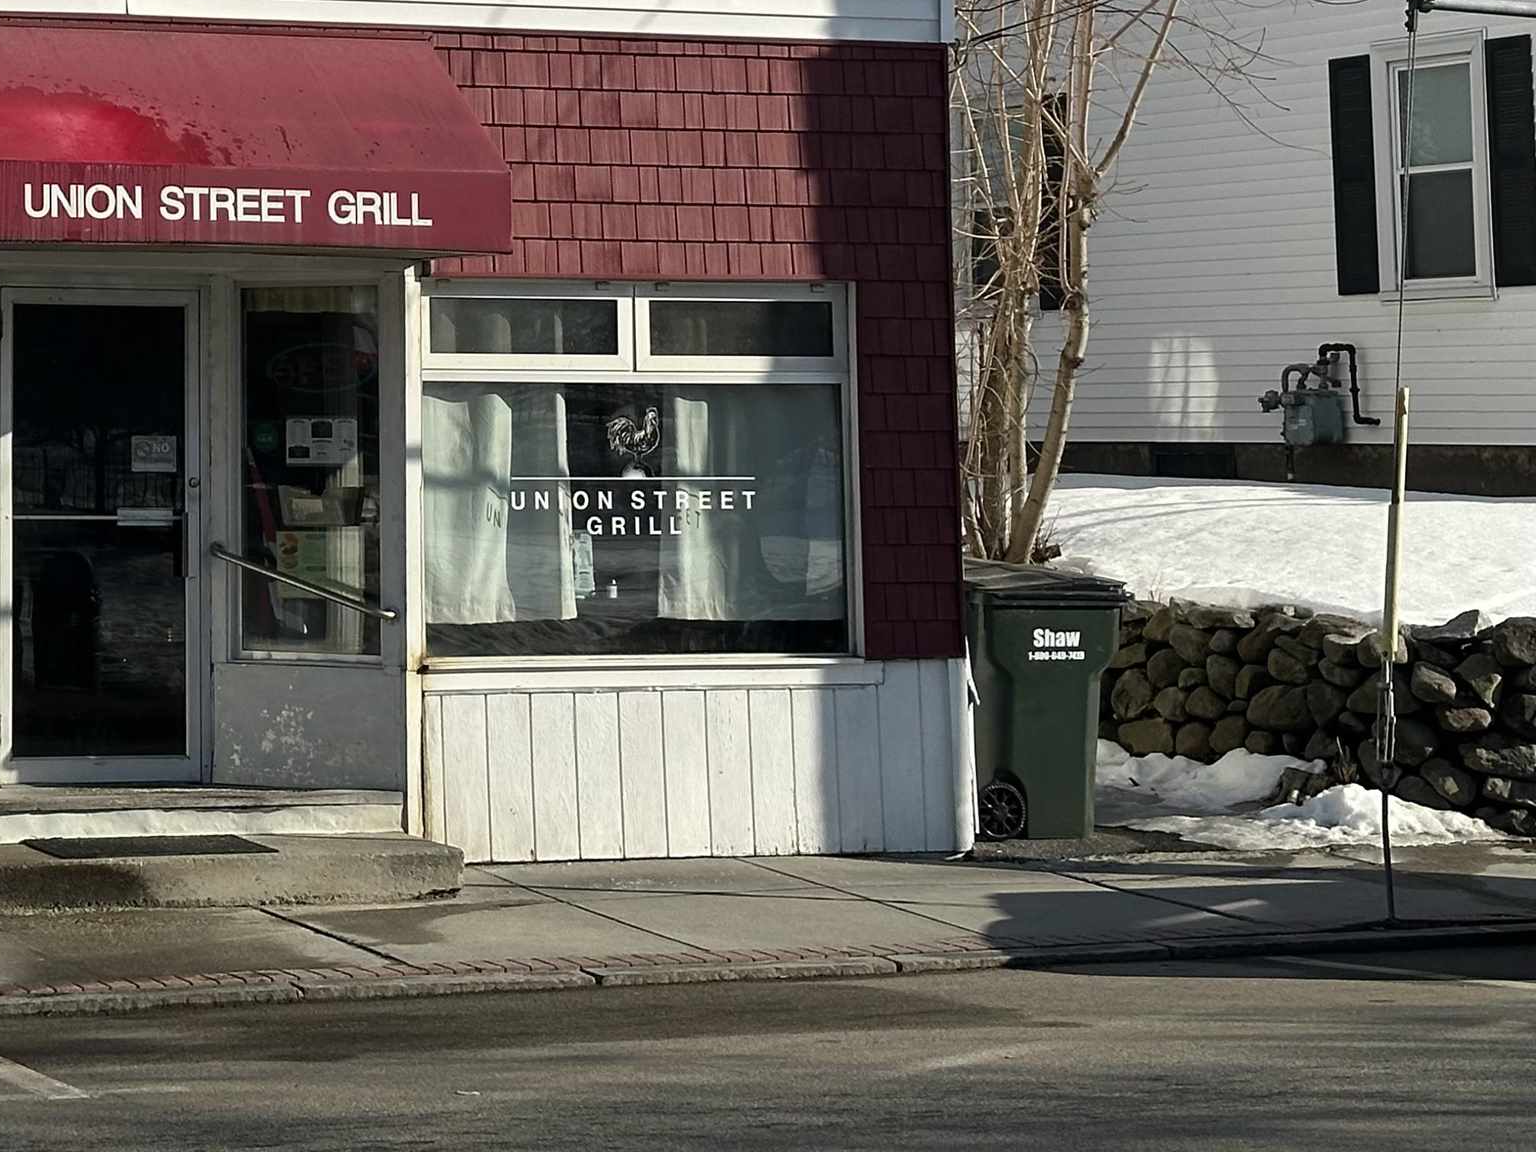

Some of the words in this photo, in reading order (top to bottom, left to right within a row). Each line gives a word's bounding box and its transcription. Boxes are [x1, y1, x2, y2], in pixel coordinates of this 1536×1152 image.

[24, 183, 143, 219] UNION
[159, 185, 311, 223] STREET
[327, 190, 433, 226] GRILL
[511, 491, 613, 510] UNION
[631, 491, 756, 510] STREET
[586, 516, 682, 535] GRILL
[1033, 628, 1081, 648] Shaw
